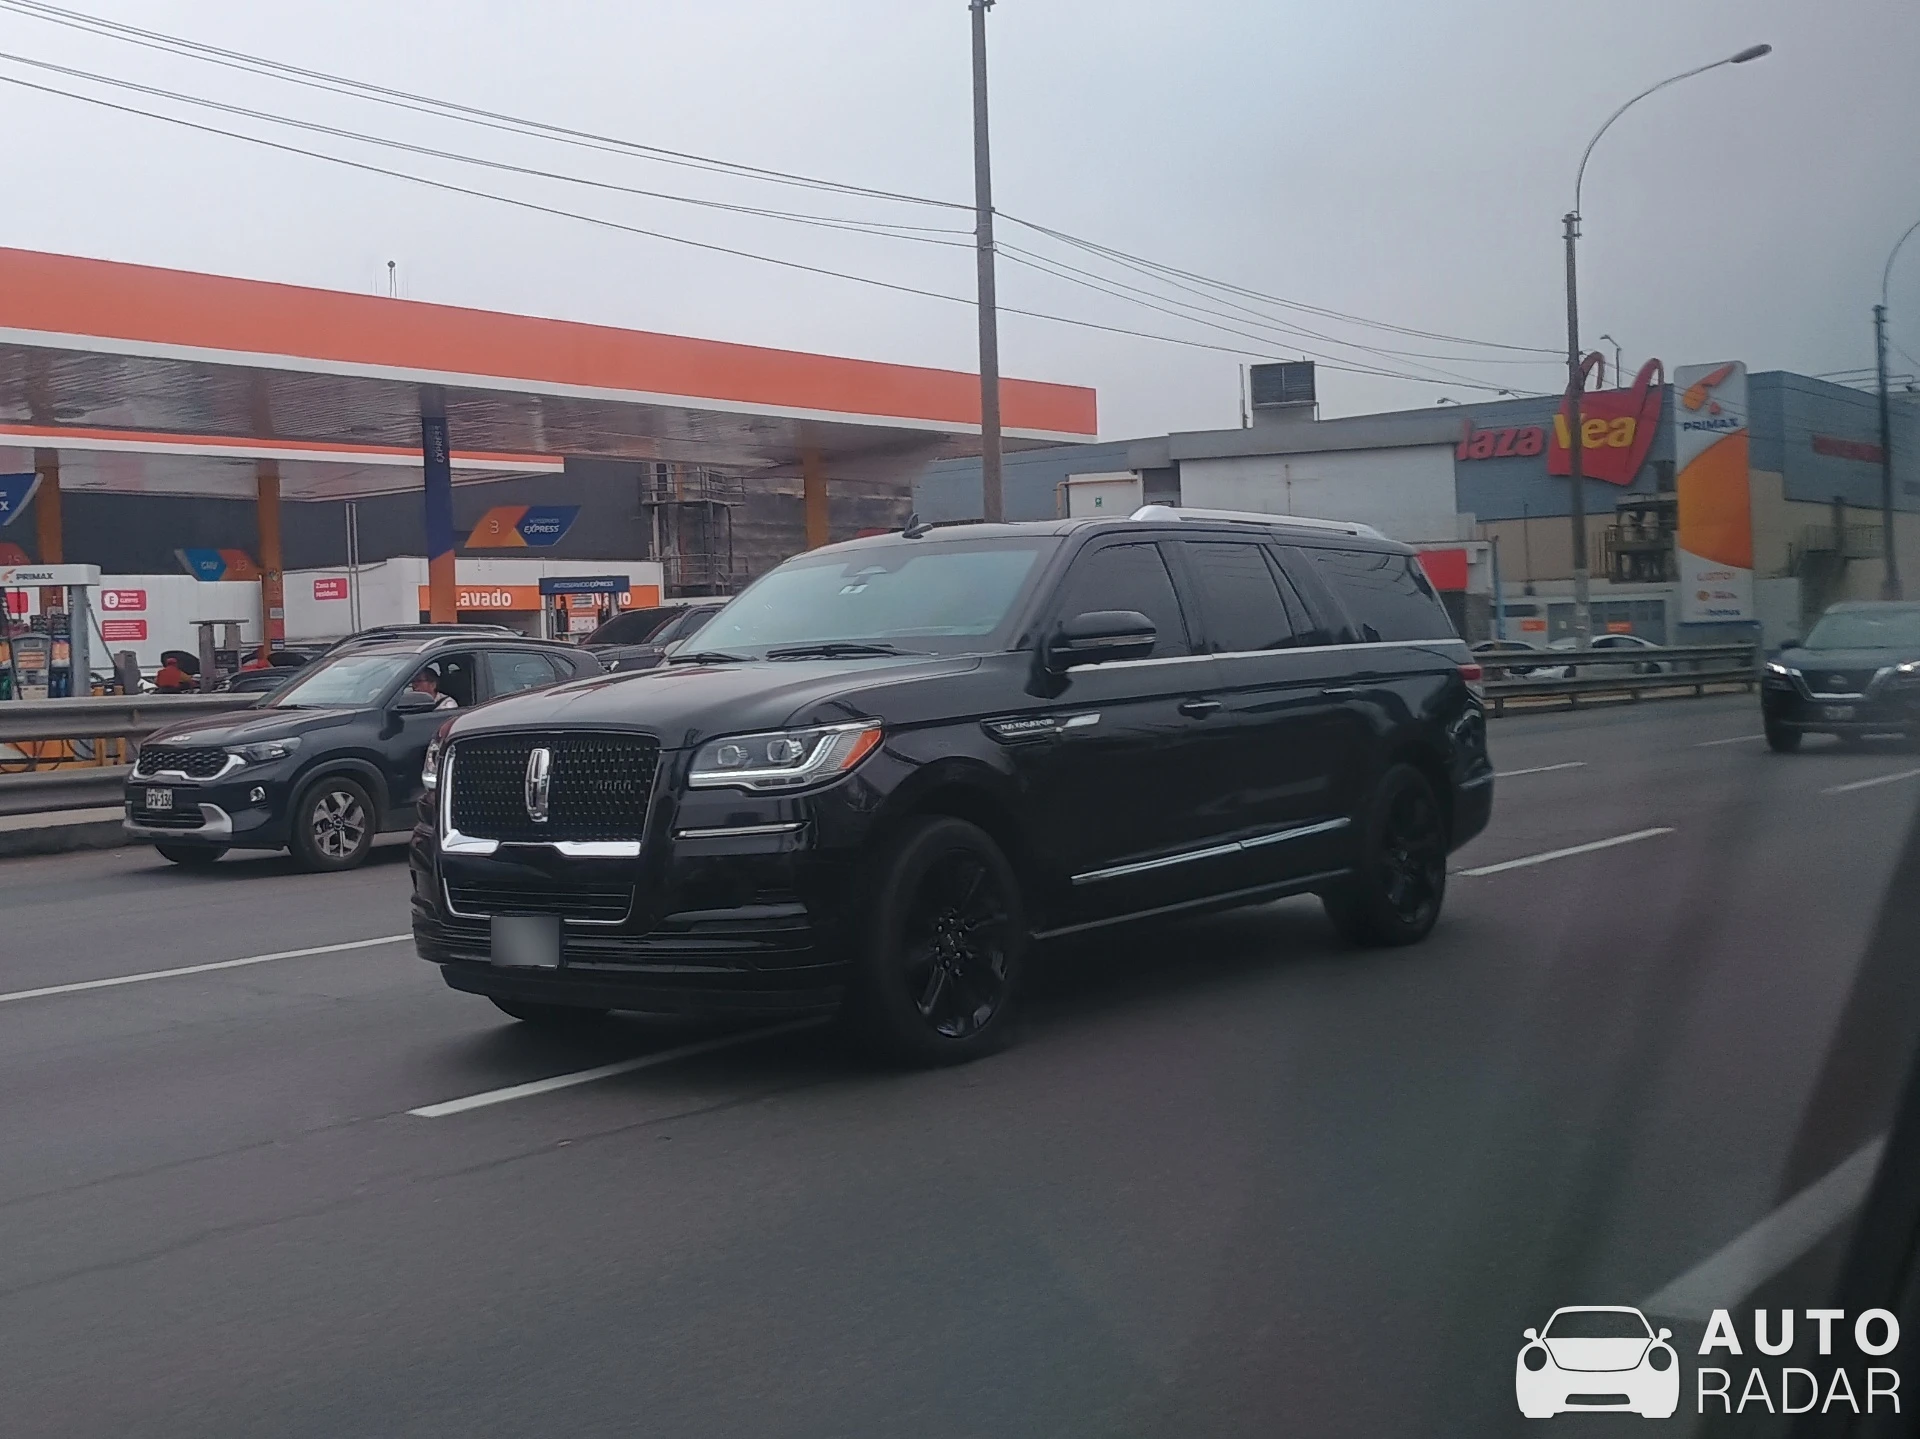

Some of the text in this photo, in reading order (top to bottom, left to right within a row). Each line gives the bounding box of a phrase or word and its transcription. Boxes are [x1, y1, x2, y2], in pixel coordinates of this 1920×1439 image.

[1683, 418, 1739, 431] PRIMAX
[1456, 413, 1636, 461] laza Vea
[489, 520, 500, 534] 3
[523, 523, 560, 535] EXPRESS
[456, 588, 512, 607] avado
[1000, 718, 1055, 730] NAVIGATOR
